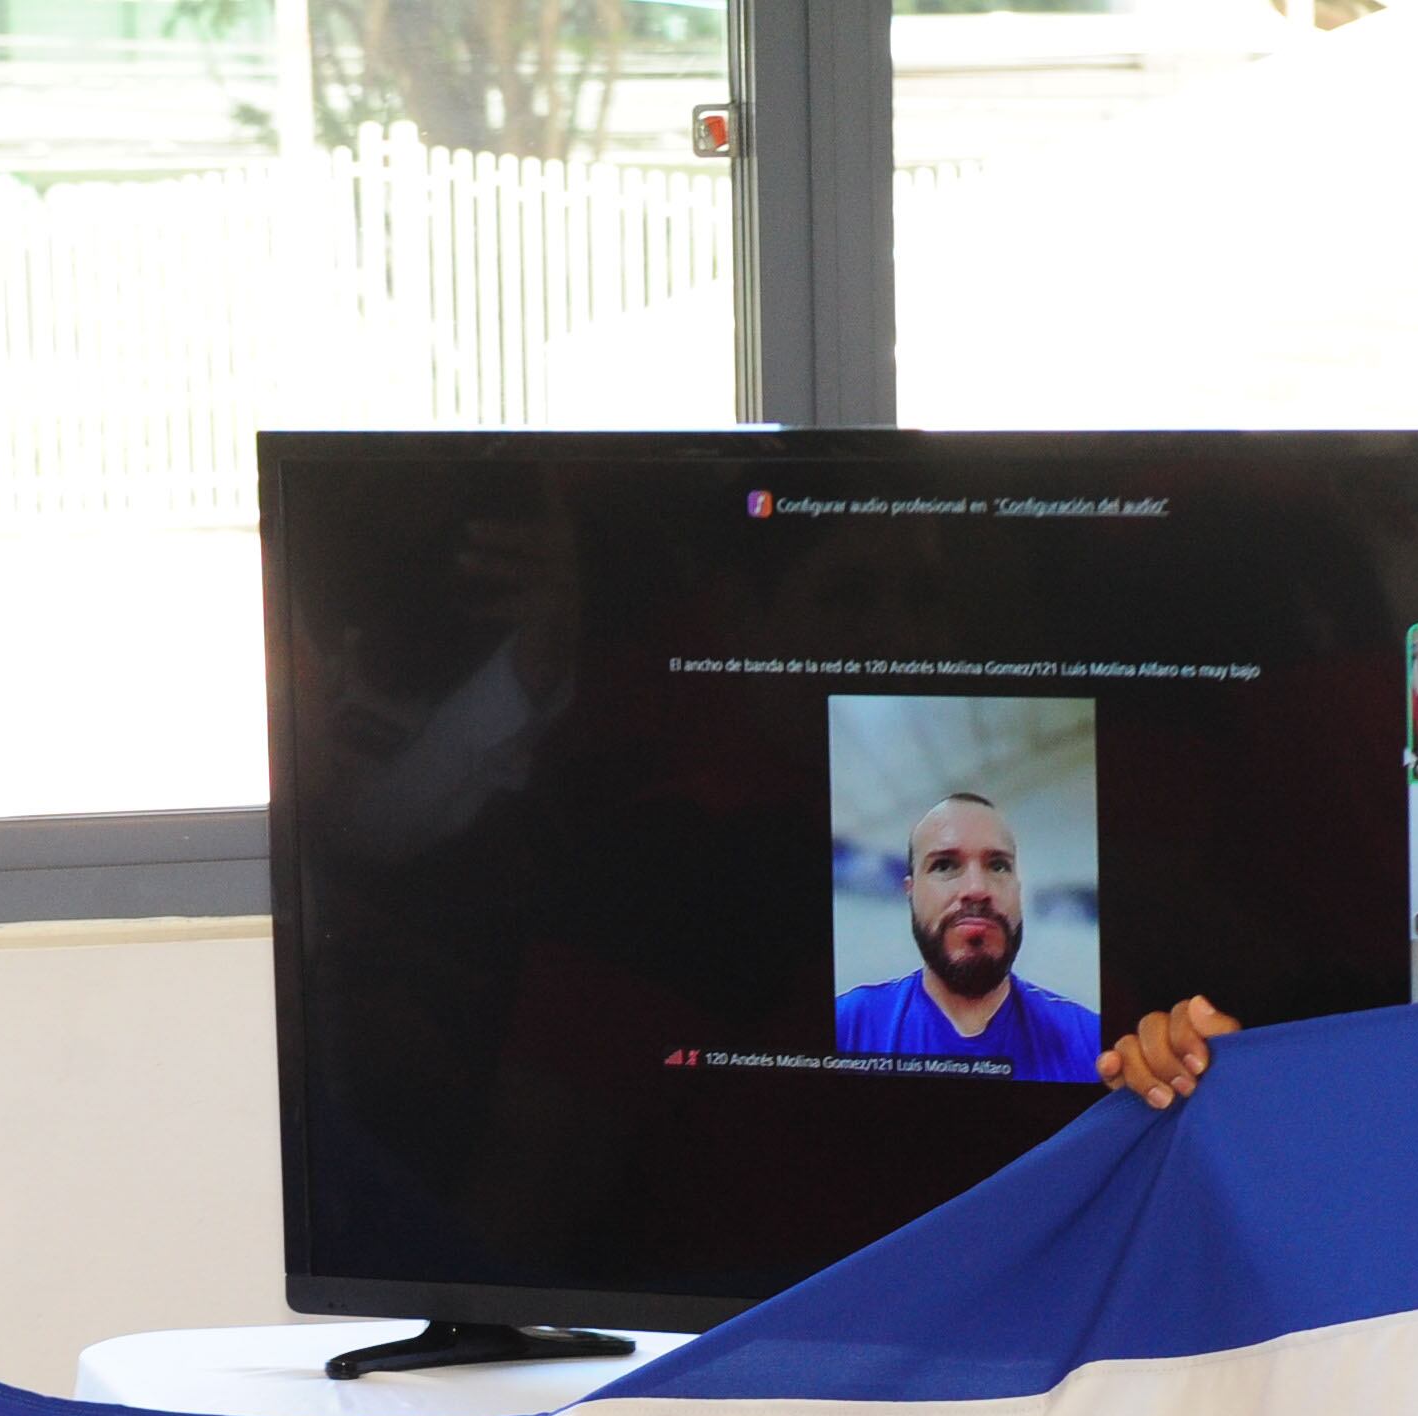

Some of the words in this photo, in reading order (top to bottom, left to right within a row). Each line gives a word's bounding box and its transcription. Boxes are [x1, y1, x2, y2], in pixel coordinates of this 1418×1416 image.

[669, 657, 681, 672] El
[684, 657, 723, 673] ancho
[725, 658, 742, 673] de
[744, 658, 784, 673] banda
[786, 658, 803, 673] de
[805, 659, 818, 673] la
[820, 658, 842, 674] red
[844, 659, 861, 674] de
[864, 660, 888, 674] 120
[936, 660, 983, 675] Molina
[1061, 661, 1088, 677] Luis
[1089, 661, 1136, 677] Molina
[1180, 664, 1197, 678] es
[1230, 663, 1261, 682] bajo
[705, 1052, 728, 1066] 120
[776, 1053, 821, 1069] Molina
[896, 1057, 923, 1072] Luis
[924, 1059, 970, 1074] Molina
[971, 1060, 1012, 1075] Alfaro
